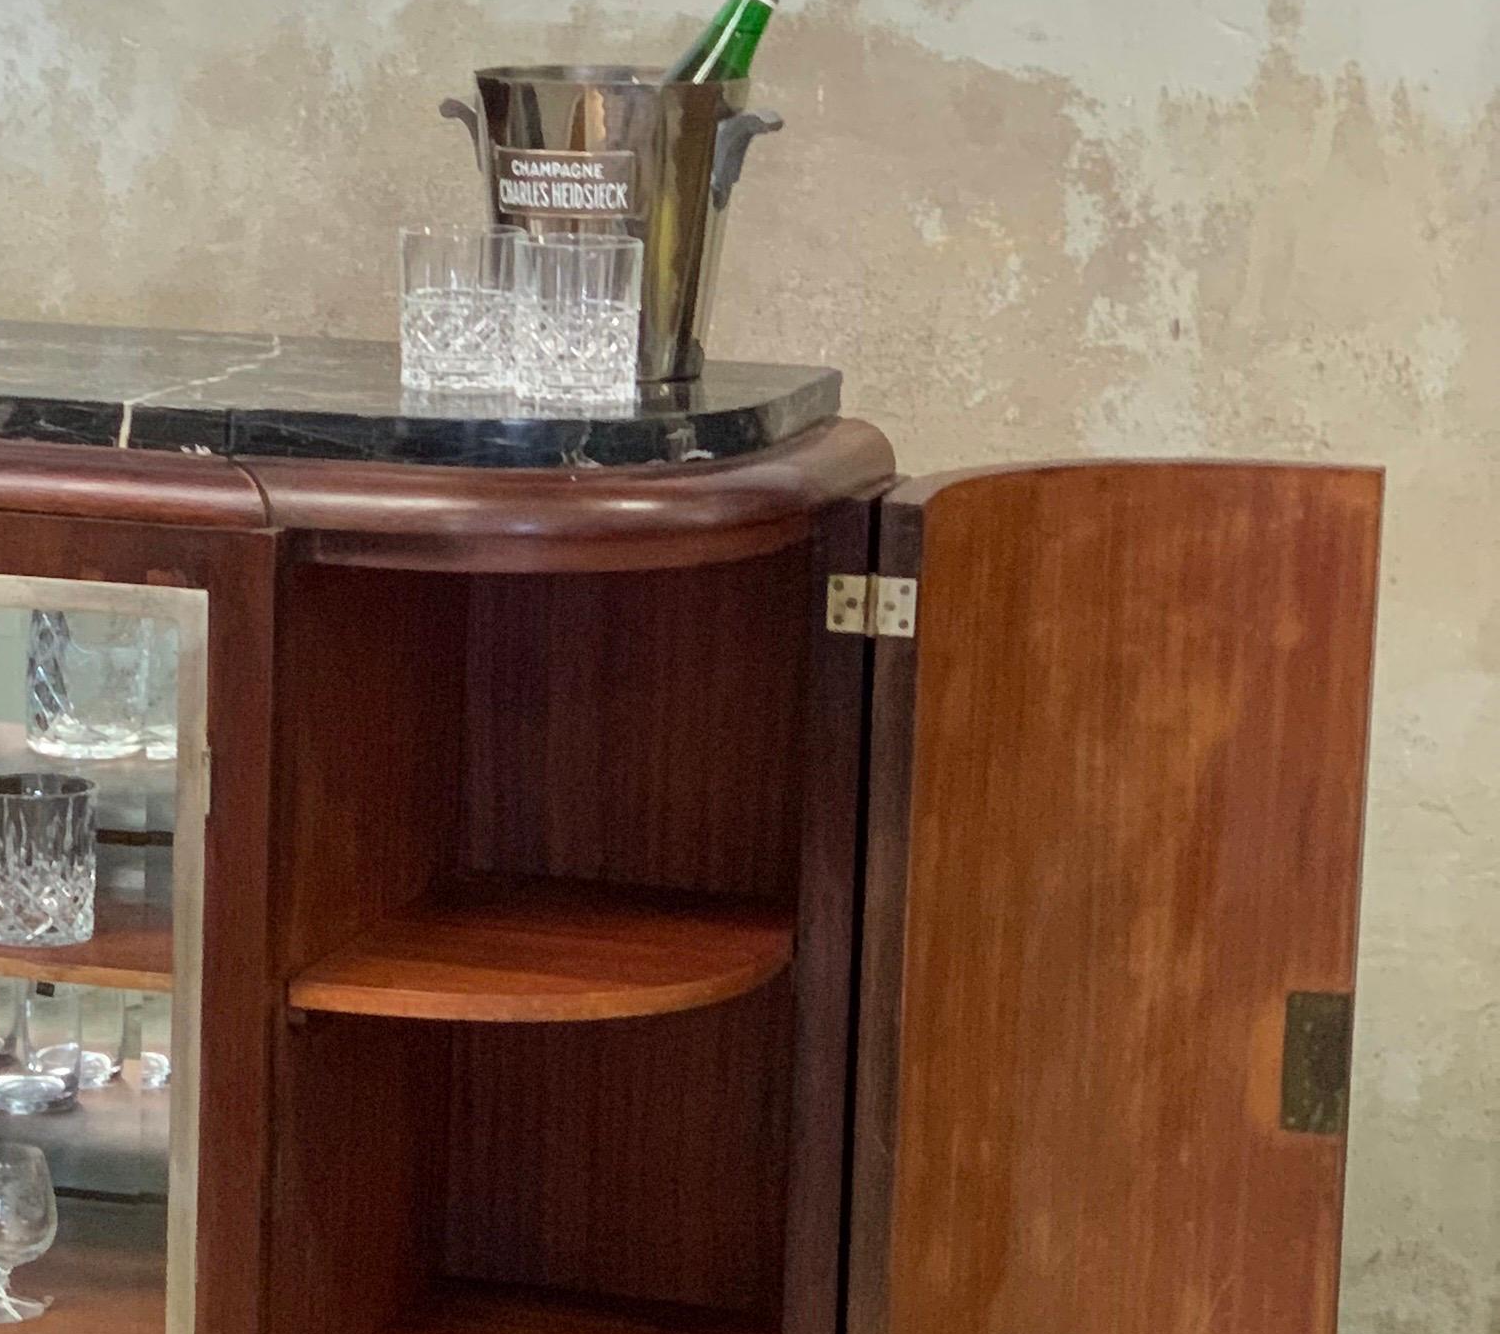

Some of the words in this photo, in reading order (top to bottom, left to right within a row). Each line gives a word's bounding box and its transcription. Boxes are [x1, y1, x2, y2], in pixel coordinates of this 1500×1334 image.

[511, 159, 604, 180] CHAMPAGNE
[500, 178, 550, 208] CHARLES
[552, 182, 629, 210] HEIDSIECK
